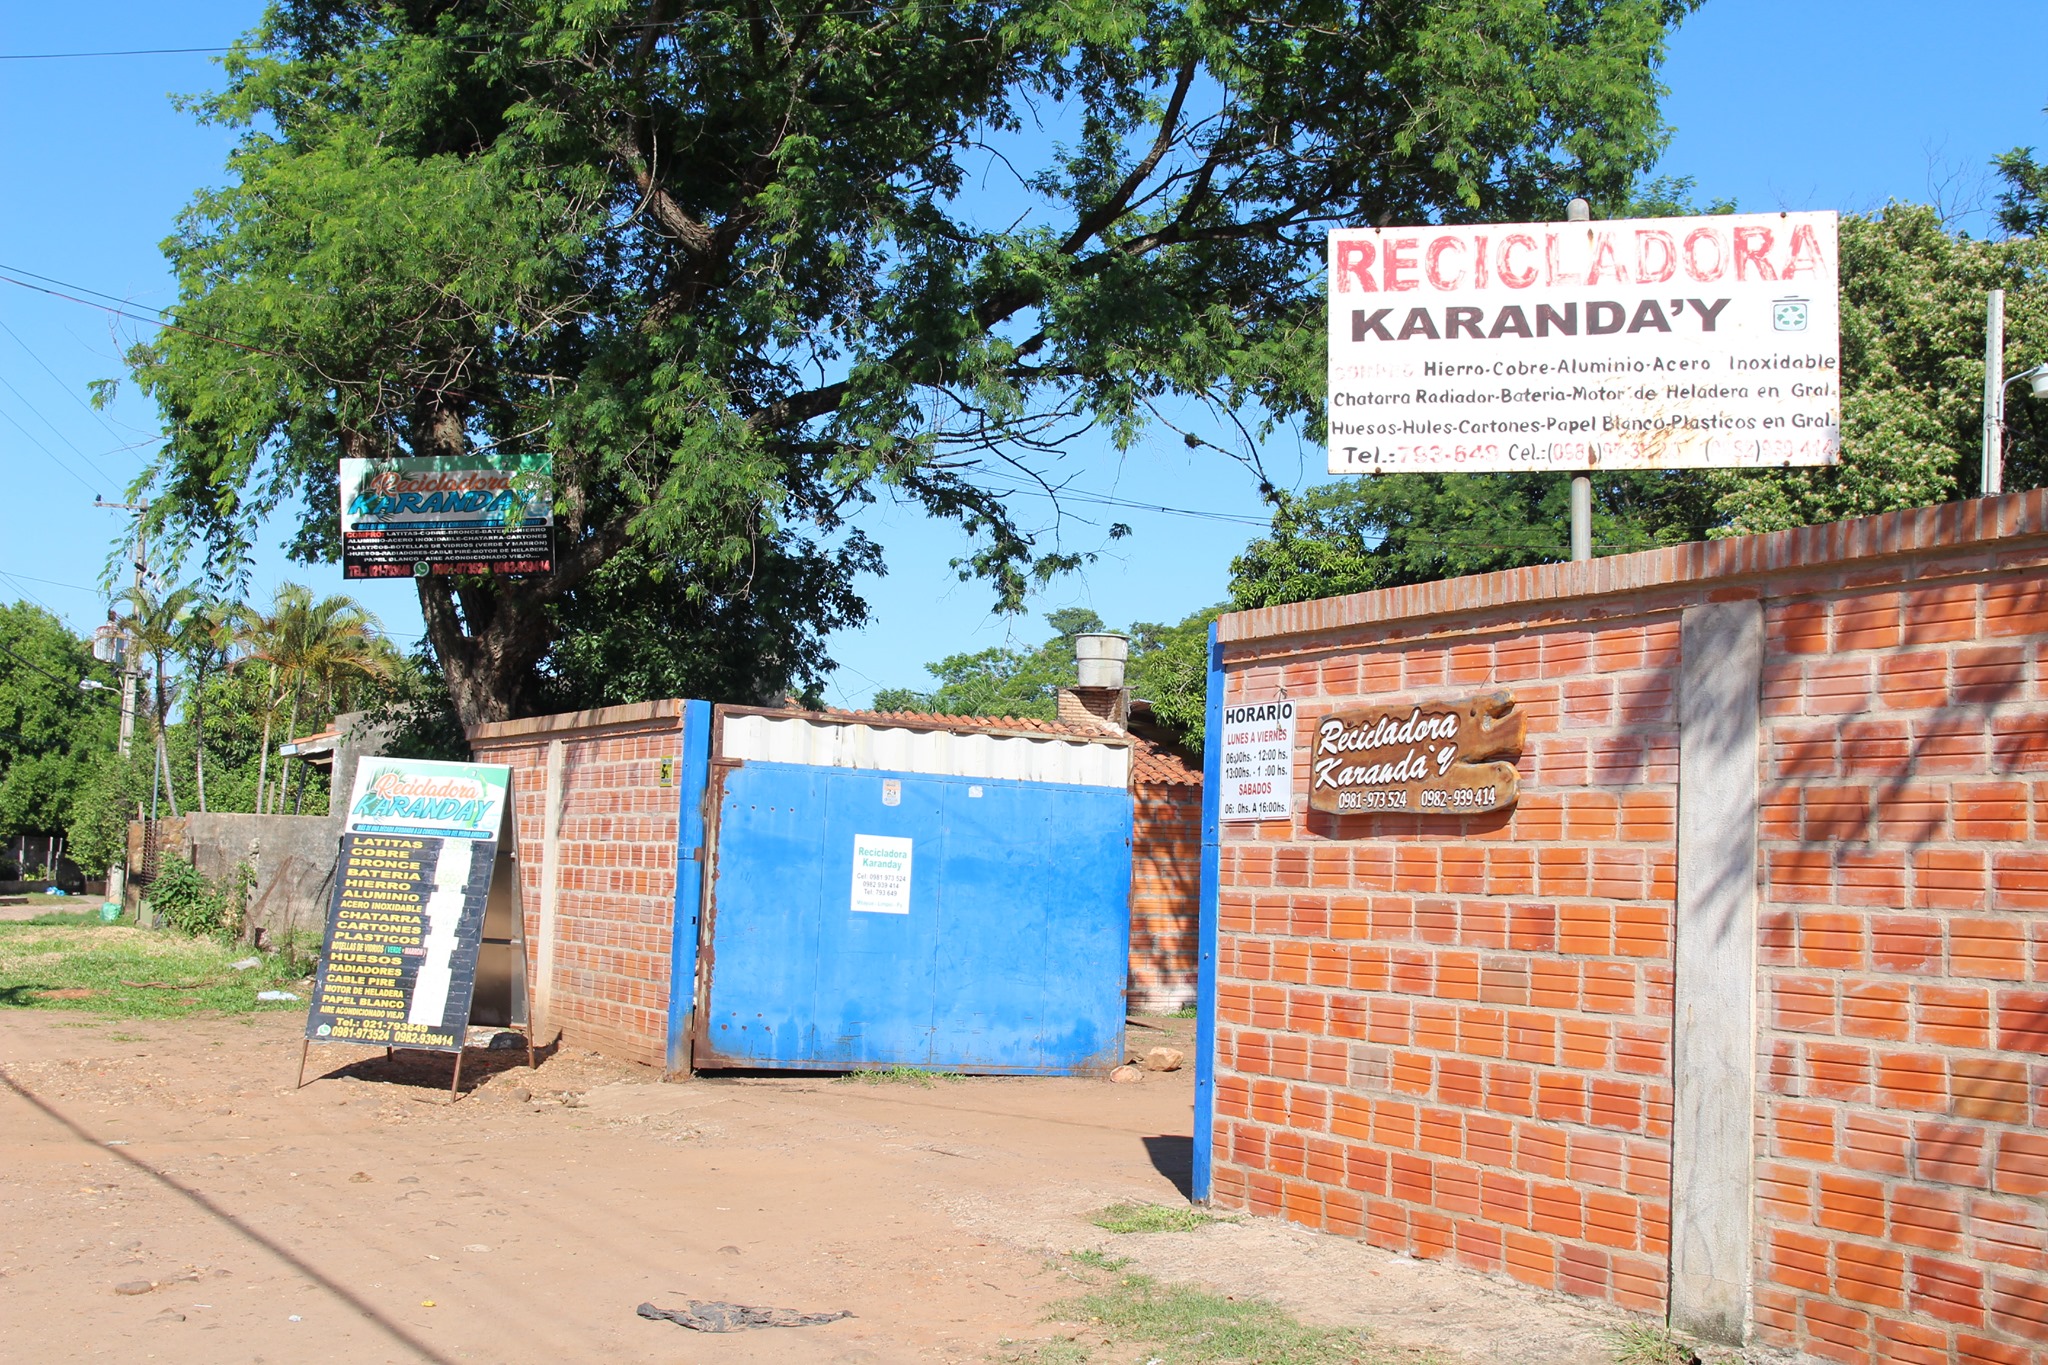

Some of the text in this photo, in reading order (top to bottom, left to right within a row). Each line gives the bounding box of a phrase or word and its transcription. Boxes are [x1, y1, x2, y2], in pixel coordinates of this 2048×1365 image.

[1336, 223, 1830, 294] RECICLADORA
[1351, 298, 1732, 343] KARANDA'Y
[1729, 353, 1835, 371] Inoxidable
[1333, 391, 1410, 407] Chatarra
[1634, 386, 1656, 400] de
[1667, 384, 1749, 399] Heladera
[1758, 387, 1780, 398] en
[1791, 382, 1835, 397] Gral.
[1763, 416, 1785, 429] en
[1792, 413, 1837, 429] Gral.
[370, 472, 511, 498] Recicladora
[445, 553, 507, 561] ACONDICIONADO
[1226, 703, 1292, 725] HORARIO
[1227, 728, 1288, 745] LUNES A VIERNES
[1318, 708, 1459, 755] Recicladora
[1258, 749, 1276, 764] 12:00
[1278, 748, 1289, 762] hs.
[1278, 764, 1288, 778] hs.
[373, 774, 480, 800] Recicladora
[352, 794, 495, 821] KARANDAY
[1252, 803, 1258, 814] A
[1259, 801, 1287, 814] 16:00hs.
[353, 837, 423, 849] LATITAS
[351, 848, 410, 859] COBRE
[858, 846, 907, 859] Recicladora
[349, 858, 421, 870] BRONCE
[862, 857, 903, 871] Karanday
[347, 868, 421, 881] BATERIA
[869, 873, 883, 881] 0981
[345, 879, 411, 891] HIERRO
[875, 888, 886, 896] 793
[877, 881, 888, 889] 939
[342, 890, 420, 902] ALUMINIO
[340, 900, 423, 913] ACERO INOXIDABLE
[339, 911, 421, 924] CHATARRA
[336, 921, 422, 934] CARTONES
[334, 931, 420, 945] PLASTICOS
[331, 941, 357, 951] BOTELLAS
[356, 943, 364, 952] DE
[364, 944, 385, 953] VIDRIOS
[330, 952, 402, 965] HUESOS
[329, 963, 402, 977] RADIADORES
[326, 974, 396, 987] CABLE PIRE
[324, 985, 404, 999] MOTOR DE HELADERA
[322, 994, 405, 1009] PAPEL BLANCO
[319, 1005, 405, 1020] AIRE ACONDICIONADO VIEJO
[336, 1017, 429, 1033] Tel.: 021-793649
[331, 1025, 454, 1046] 0981-973524 0982-939414
